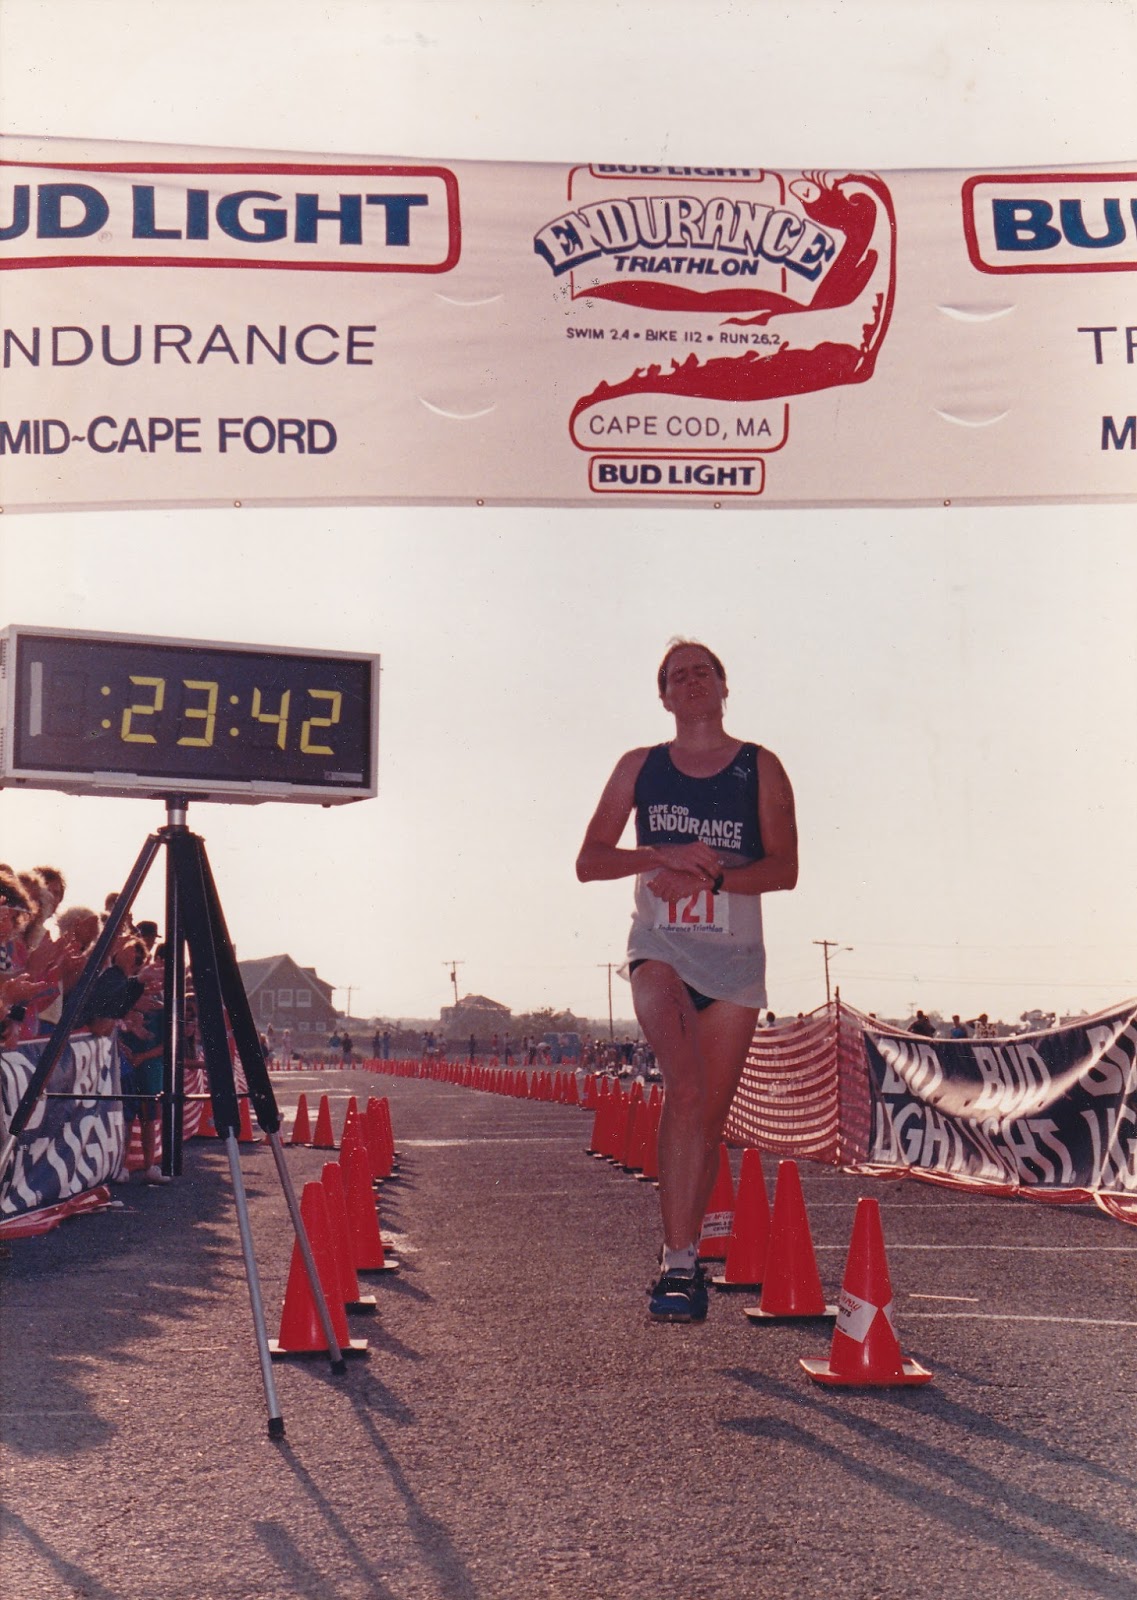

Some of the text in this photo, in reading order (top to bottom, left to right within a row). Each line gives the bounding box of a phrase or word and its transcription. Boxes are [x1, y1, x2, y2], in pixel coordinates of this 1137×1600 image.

[132, 185, 429, 246] LIGHT
[992, 198, 1137, 251] BU
[534, 196, 836, 282] ENDURANCE
[613, 255, 759, 276] TRIATHLON
[3, 324, 377, 368] NDURANCE
[566, 327, 604, 340] SWIM
[610, 329, 630, 341] 2.4
[645, 330, 677, 342] BIKE
[684, 332, 702, 343] 112
[719, 332, 749, 345] RUN
[1077, 326, 1137, 364] T
[218, 415, 338, 455] FORD
[589, 415, 772, 441] CAPE COD, MA
[599, 464, 756, 486] BUD LIGHT
[648, 804, 690, 816] CAPE COD
[649, 815, 742, 839] ENDURANCE
[698, 836, 742, 850] TRIATHLON
[971, 1044, 1051, 1113] BUD
